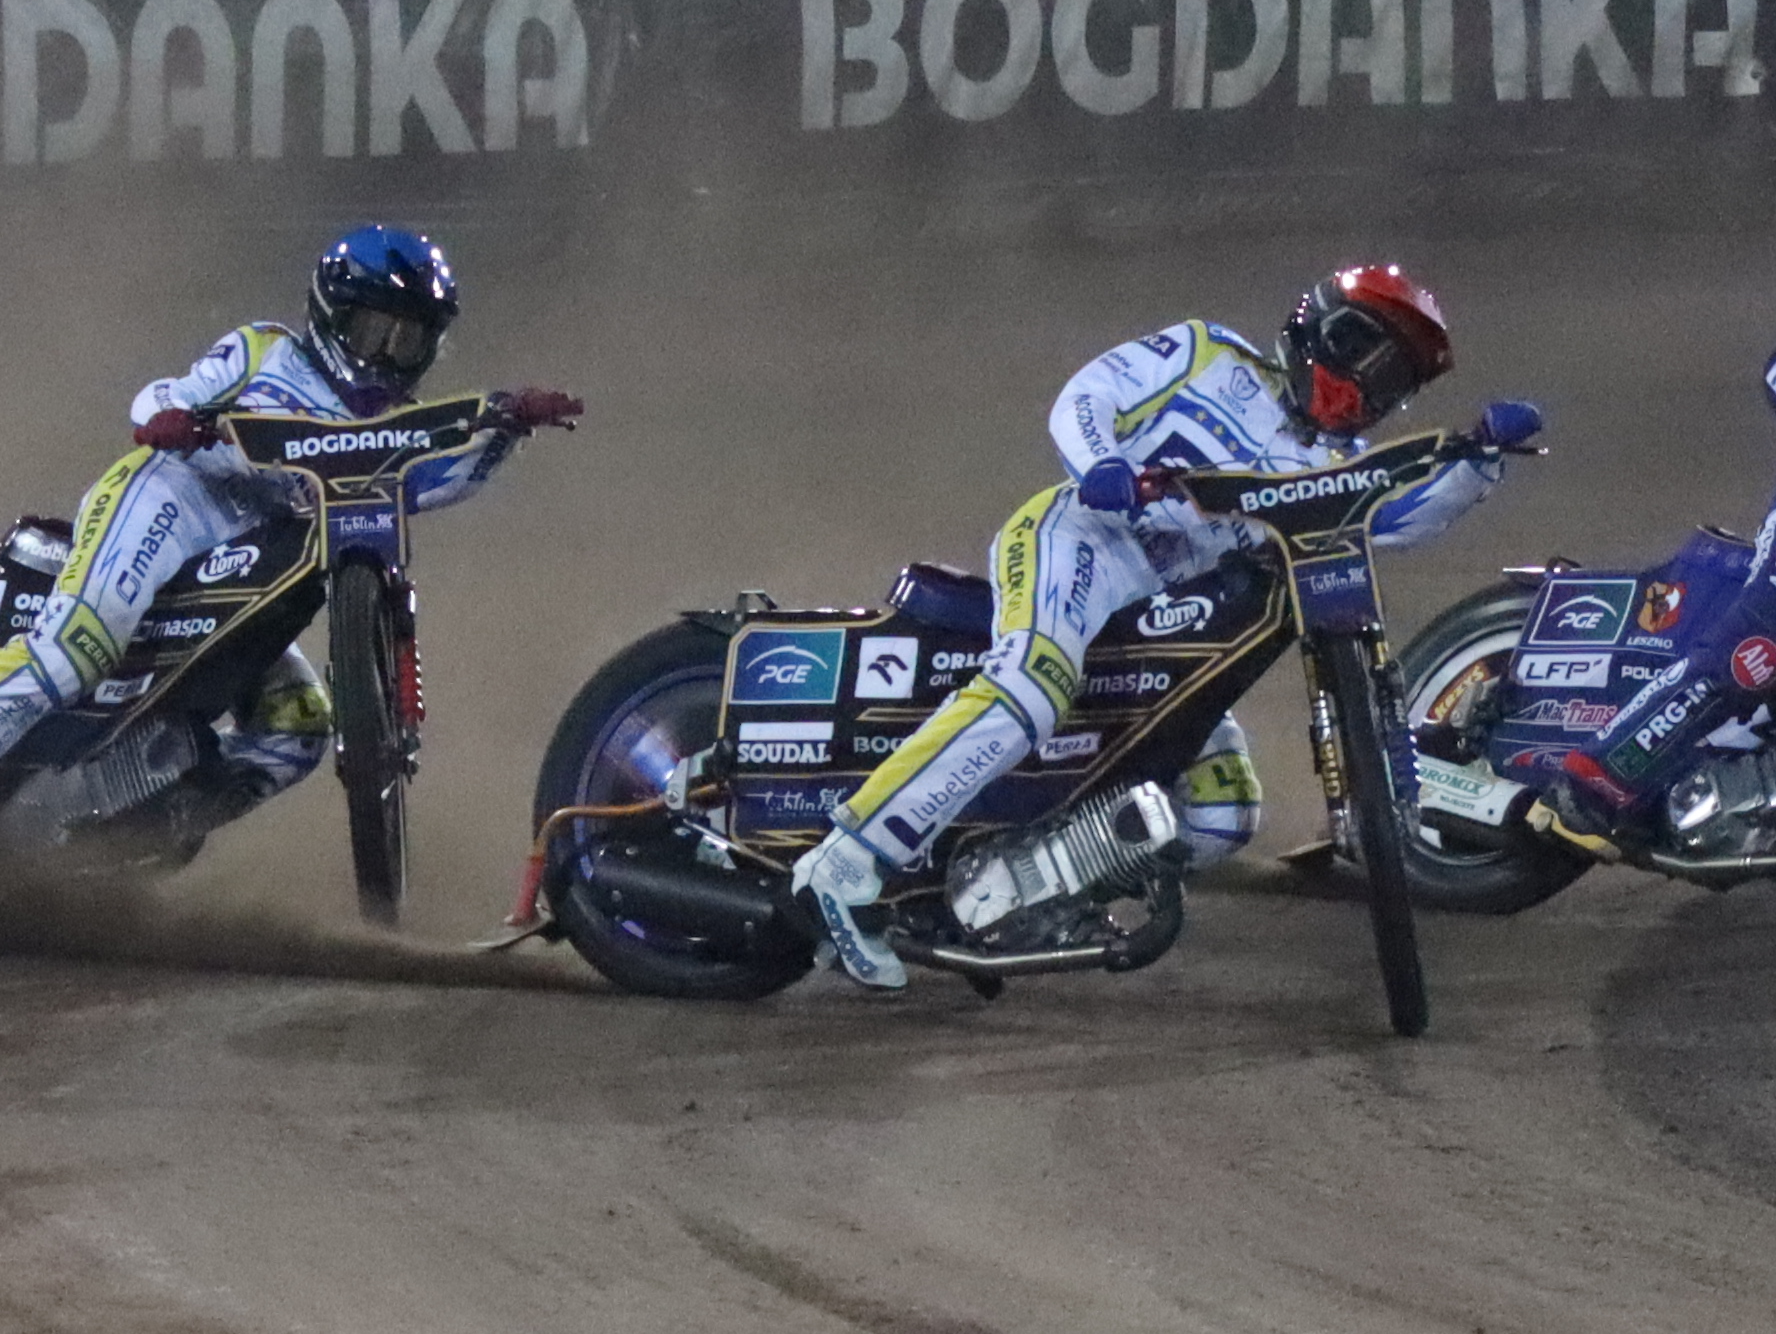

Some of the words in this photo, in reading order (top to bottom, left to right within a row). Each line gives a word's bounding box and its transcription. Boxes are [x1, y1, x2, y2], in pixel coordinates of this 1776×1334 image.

[285, 431, 431, 459] BOGDANKA
[1240, 469, 1391, 512] BOGDANKA
[132, 501, 179, 578] maspo
[209, 549, 249, 576] LOTTO
[15, 594, 45, 610] OR
[1154, 601, 1199, 627] LOTTO
[1558, 612, 1604, 628] PGE
[153, 618, 217, 637] maspo
[1627, 636, 1673, 650] LESZNO
[759, 665, 813, 683] PGE
[1525, 662, 1590, 679] LFP
[1088, 673, 1170, 693] maspo
[1536, 700, 1619, 724] MacTrans
[738, 743, 831, 763] SOUDAL
